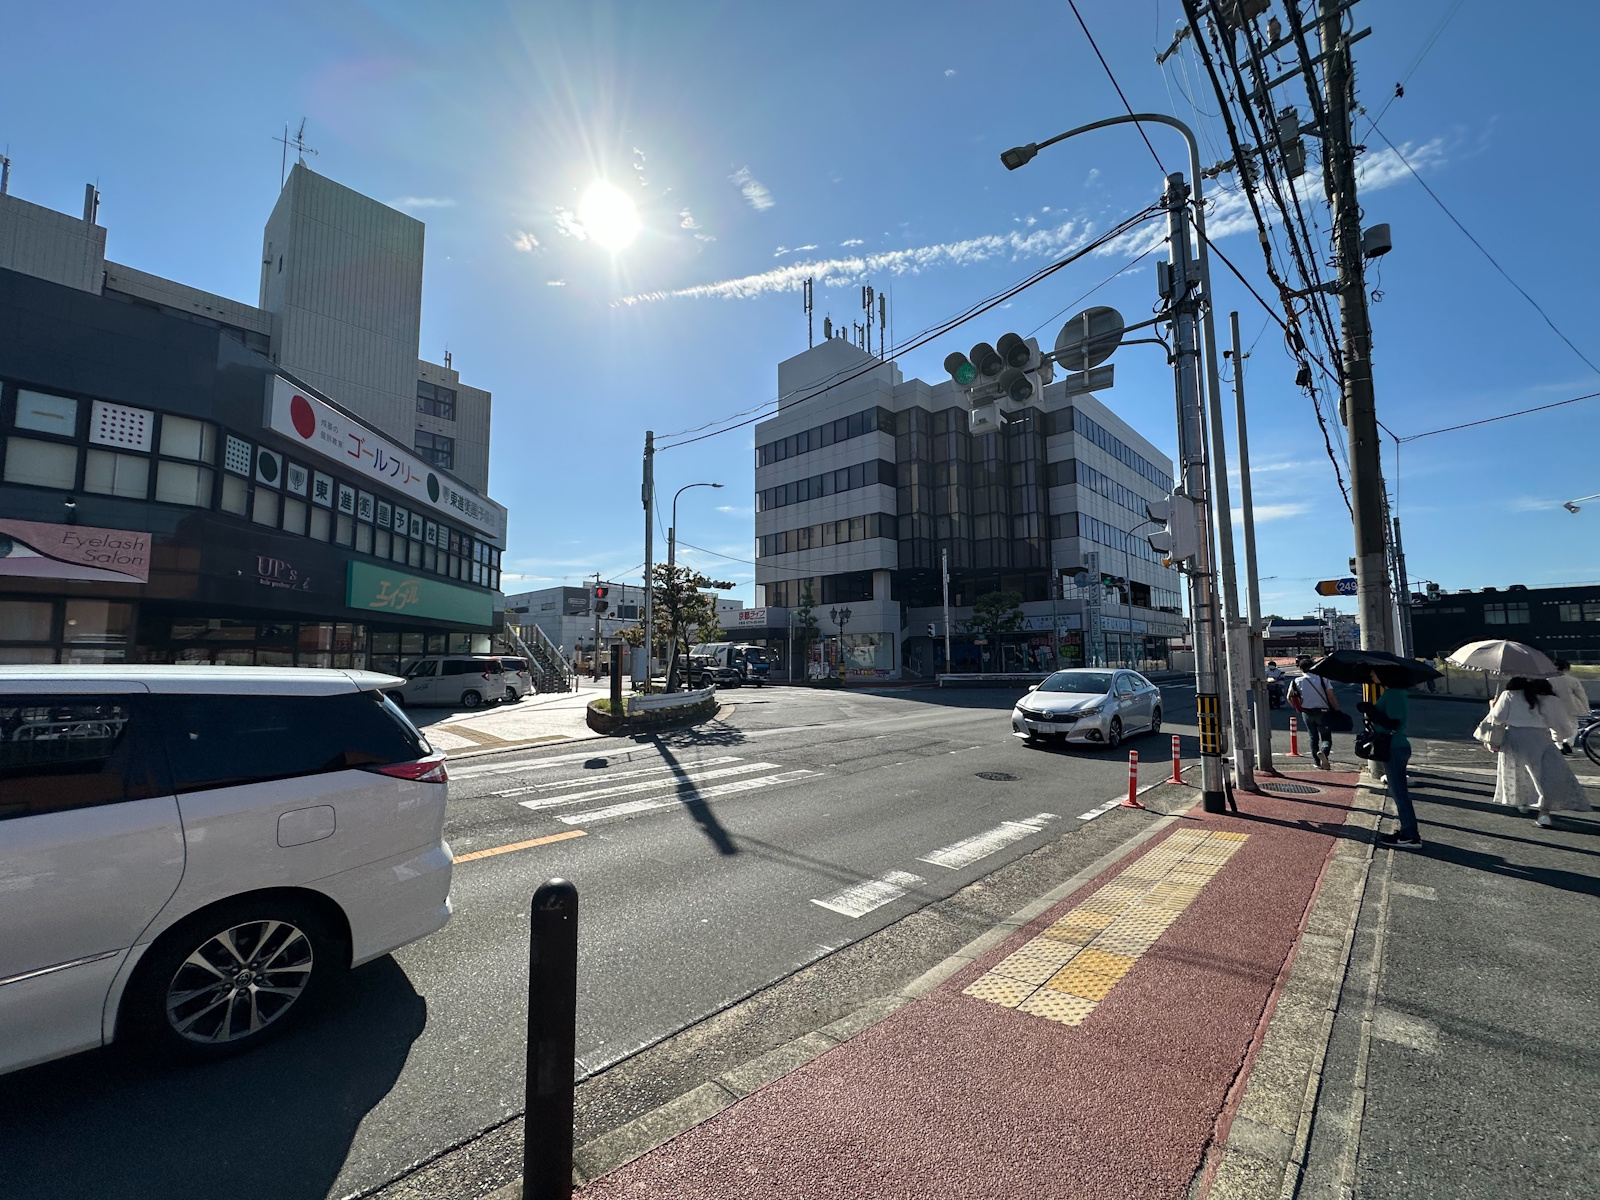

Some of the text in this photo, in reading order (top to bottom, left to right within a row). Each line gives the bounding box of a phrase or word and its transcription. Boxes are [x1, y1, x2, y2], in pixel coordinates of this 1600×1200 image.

[347, 433, 421, 484] ゴールフリー
[62, 531, 144, 551] Eyelash
[82, 549, 143, 566] Salon
[368, 578, 421, 610] エイブル
